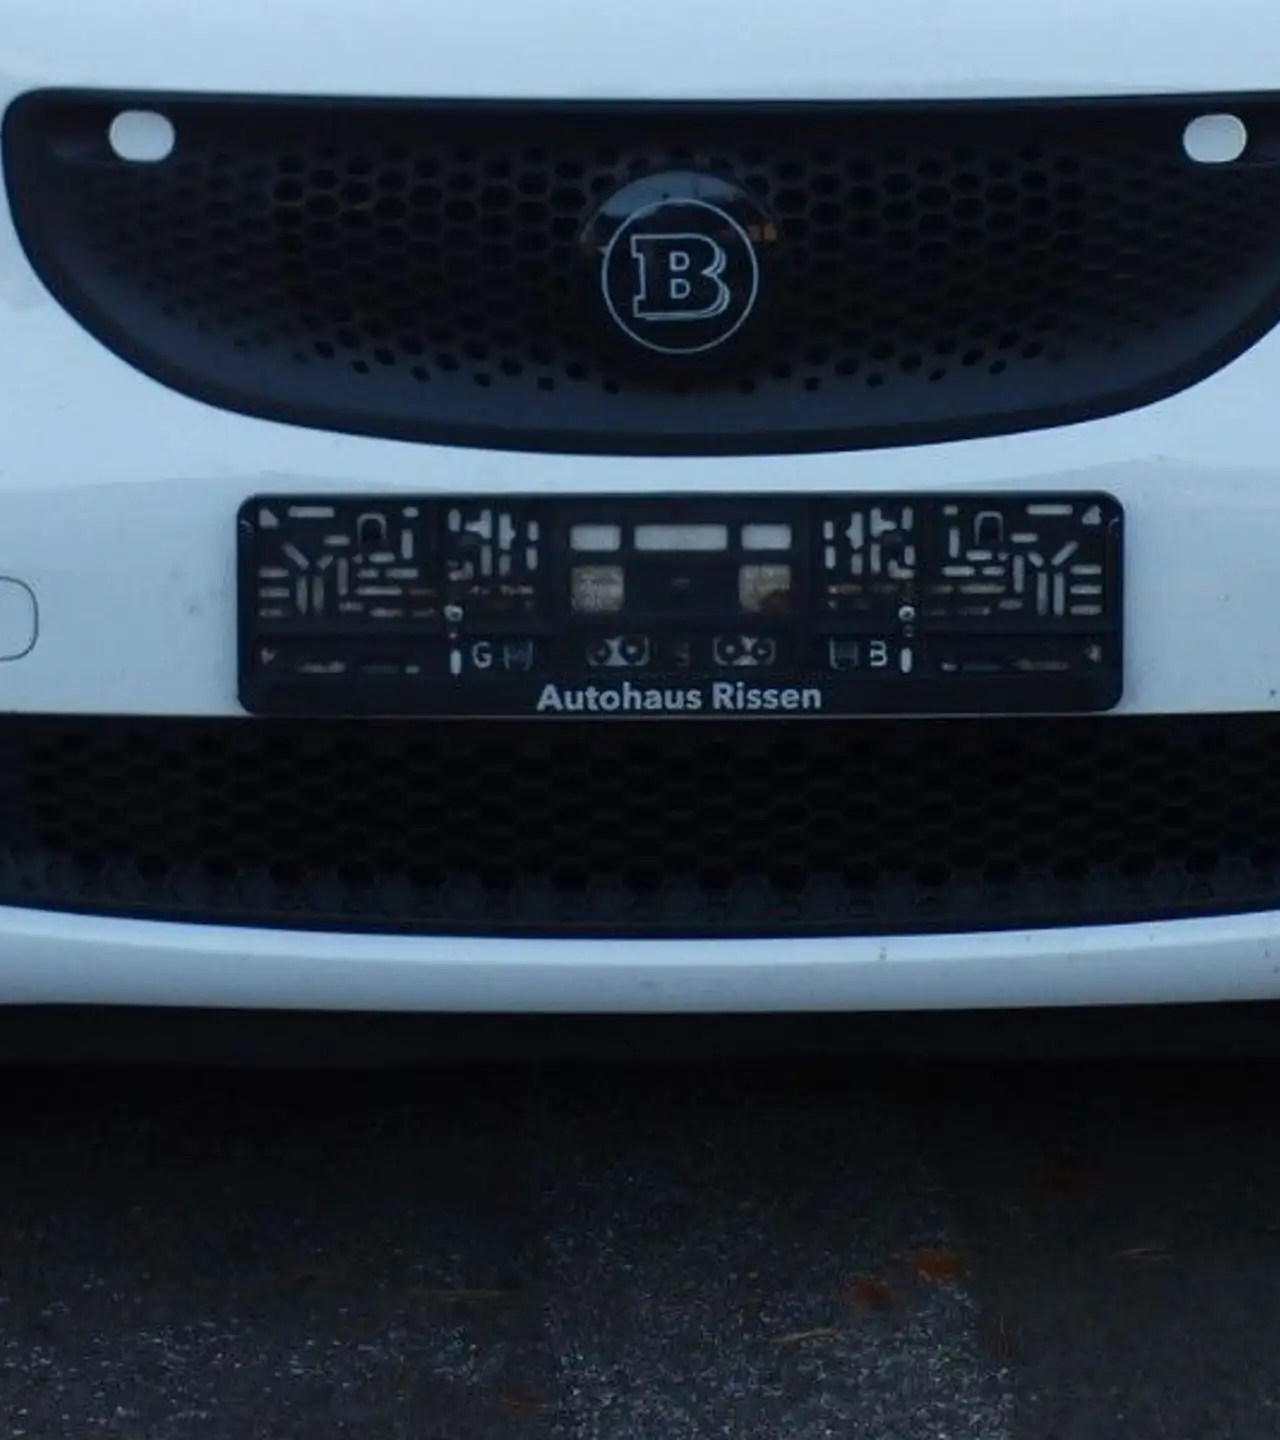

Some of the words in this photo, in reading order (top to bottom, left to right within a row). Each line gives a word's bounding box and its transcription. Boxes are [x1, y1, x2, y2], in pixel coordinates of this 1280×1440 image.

[630, 233, 730, 321] B
[536, 681, 702, 711] Autohaus
[711, 681, 822, 710] Rissen
